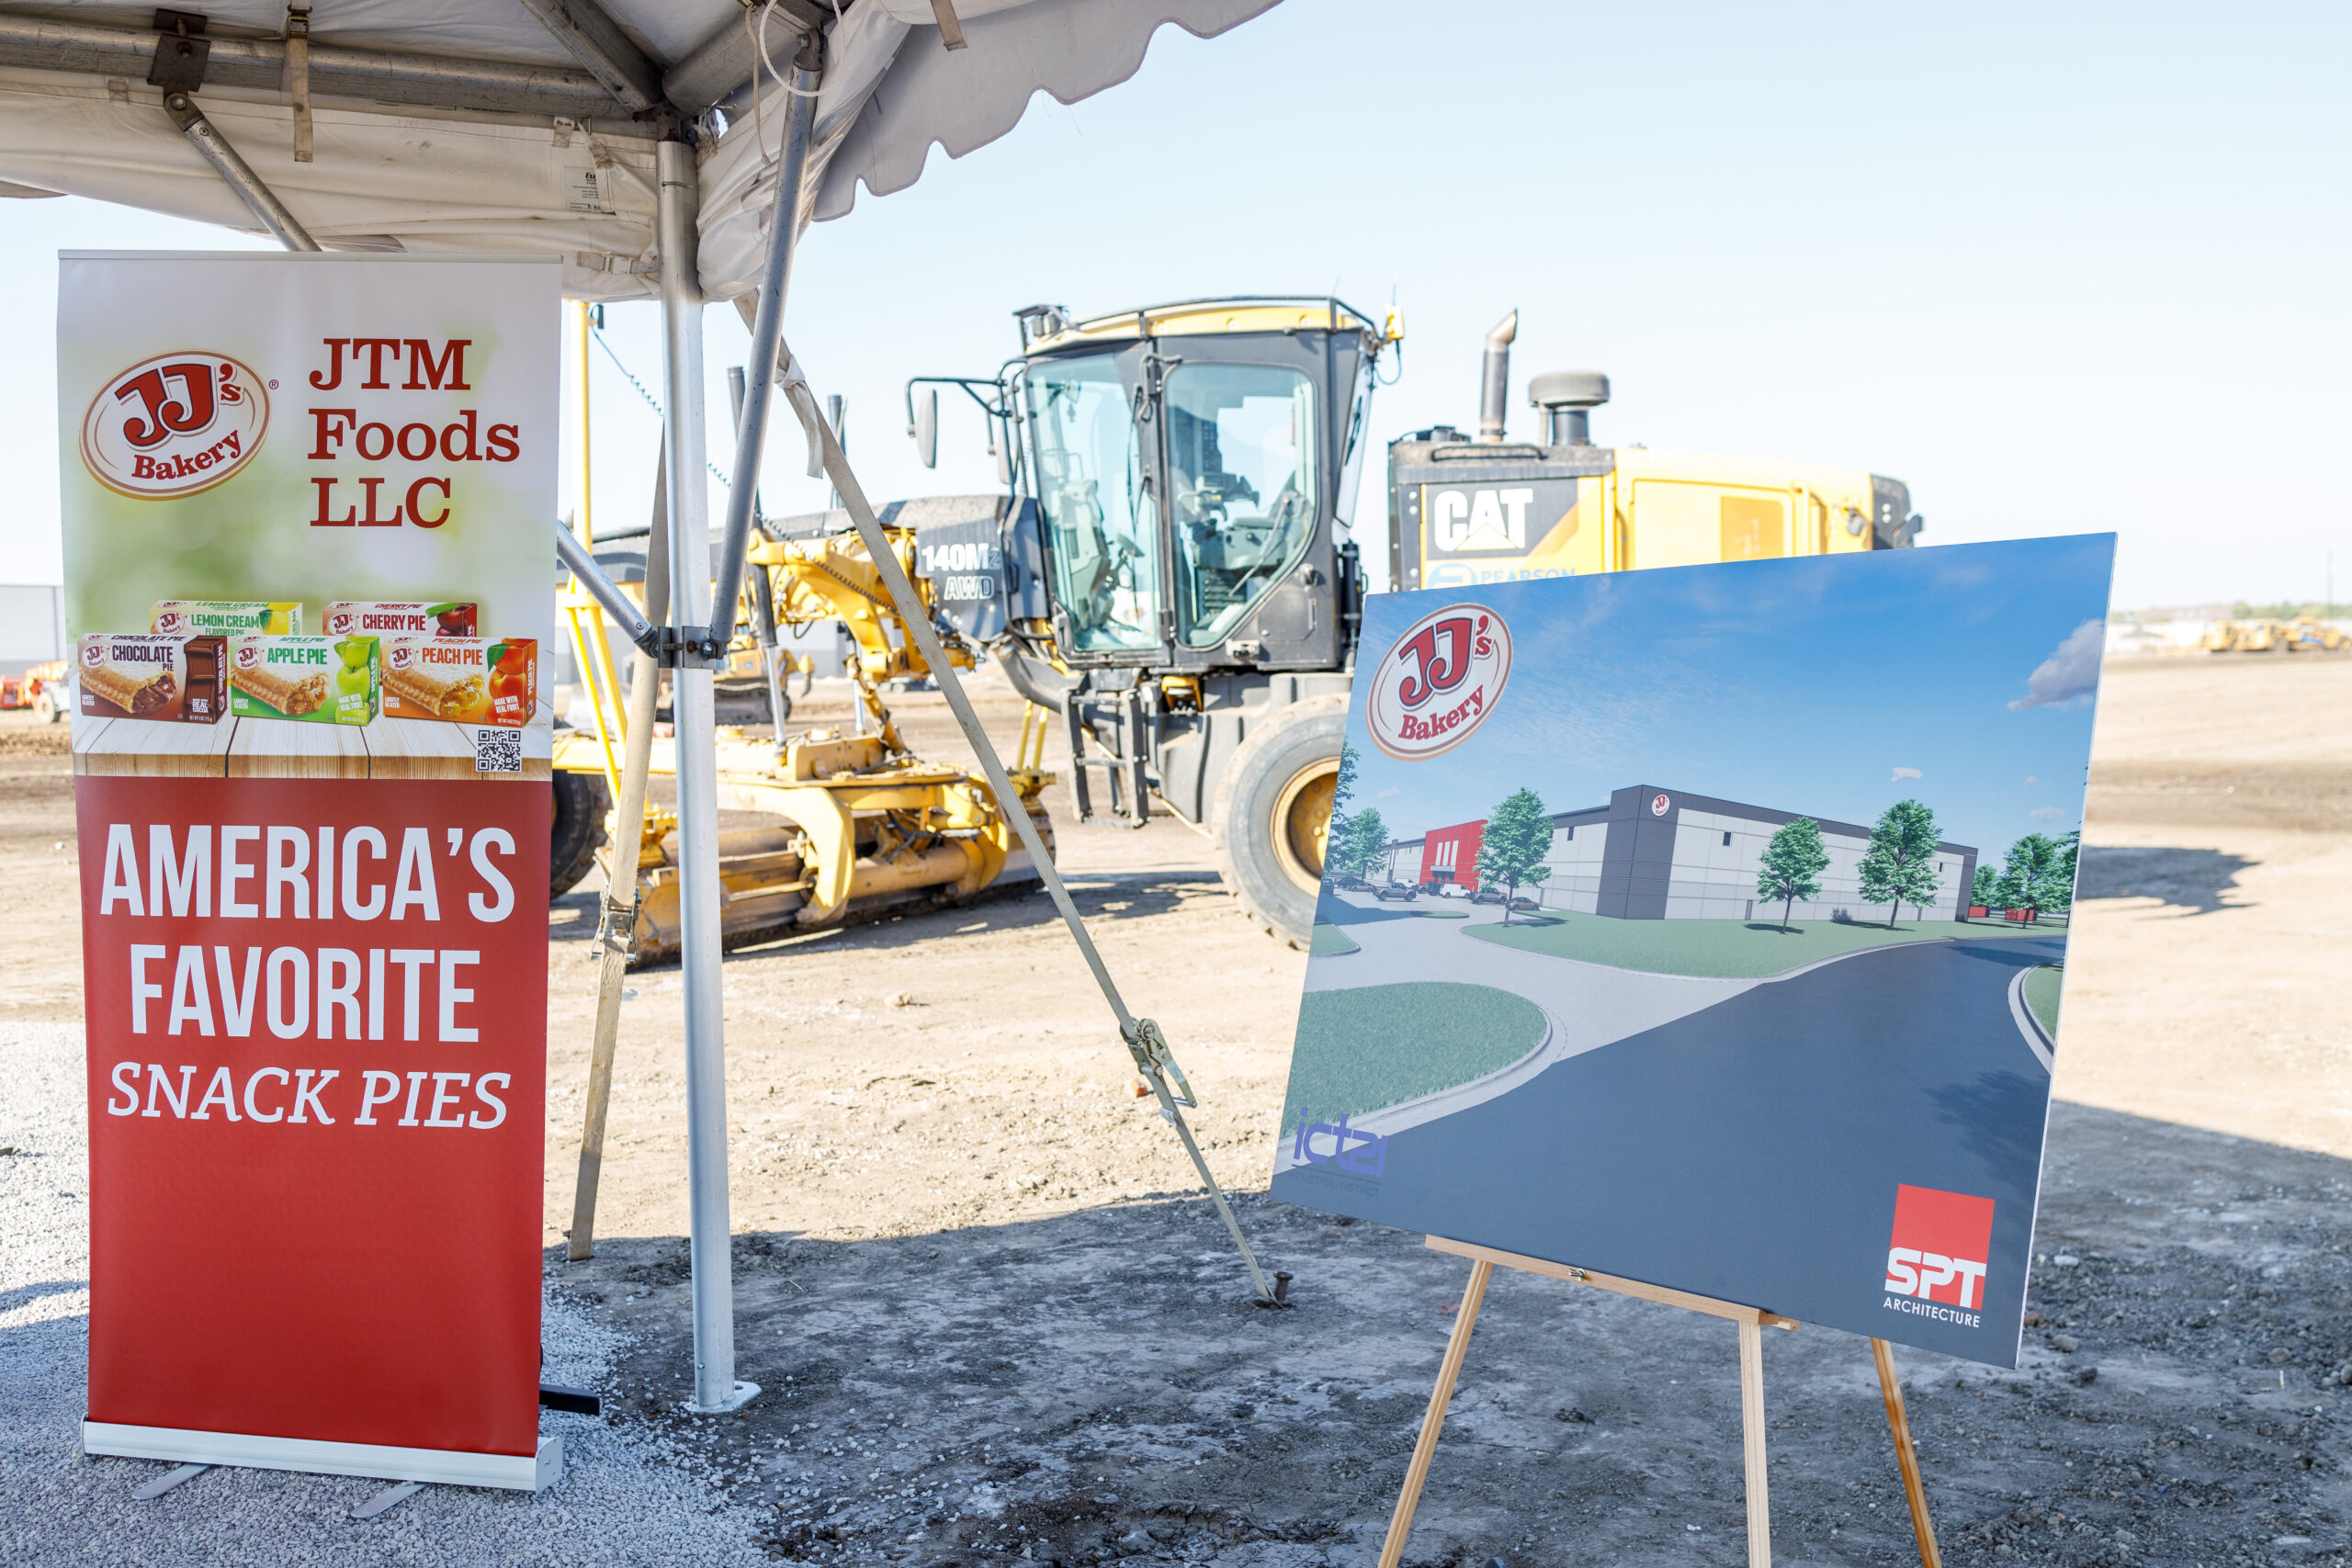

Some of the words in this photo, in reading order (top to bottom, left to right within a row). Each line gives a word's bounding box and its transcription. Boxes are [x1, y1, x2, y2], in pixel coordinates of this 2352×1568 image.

[309, 338, 472, 391] JTM
[114, 363, 242, 448] JJ's
[131, 429, 243, 480] Bakery
[307, 408, 521, 462] Foods
[310, 477, 451, 528] LLC
[1434, 488, 1533, 552] CAT
[944, 575, 994, 601] AWD
[191, 614, 224, 626] LEMON
[226, 615, 259, 628] CREAM
[206, 628, 235, 637] FLAVORED
[363, 615, 406, 630] CHERRY
[408, 615, 426, 631] PIE
[112, 645, 174, 663] CHOCOLATE
[162, 662, 175, 671] PIE
[266, 648, 305, 664] APPLE
[307, 649, 328, 665] PIE
[422, 647, 461, 665] PEACH
[463, 649, 483, 666] PIE
[1398, 615, 1492, 707] JJ's
[1398, 684, 1484, 740] Bakery
[100, 823, 516, 923] AMERICA'S
[130, 943, 481, 1043] FAVORITE
[107, 1061, 340, 1125] SNACK
[354, 1069, 511, 1130] PIES
[1884, 1247, 1987, 1309] SPT
[1883, 1296, 1981, 1328] ARCHITECTURE
